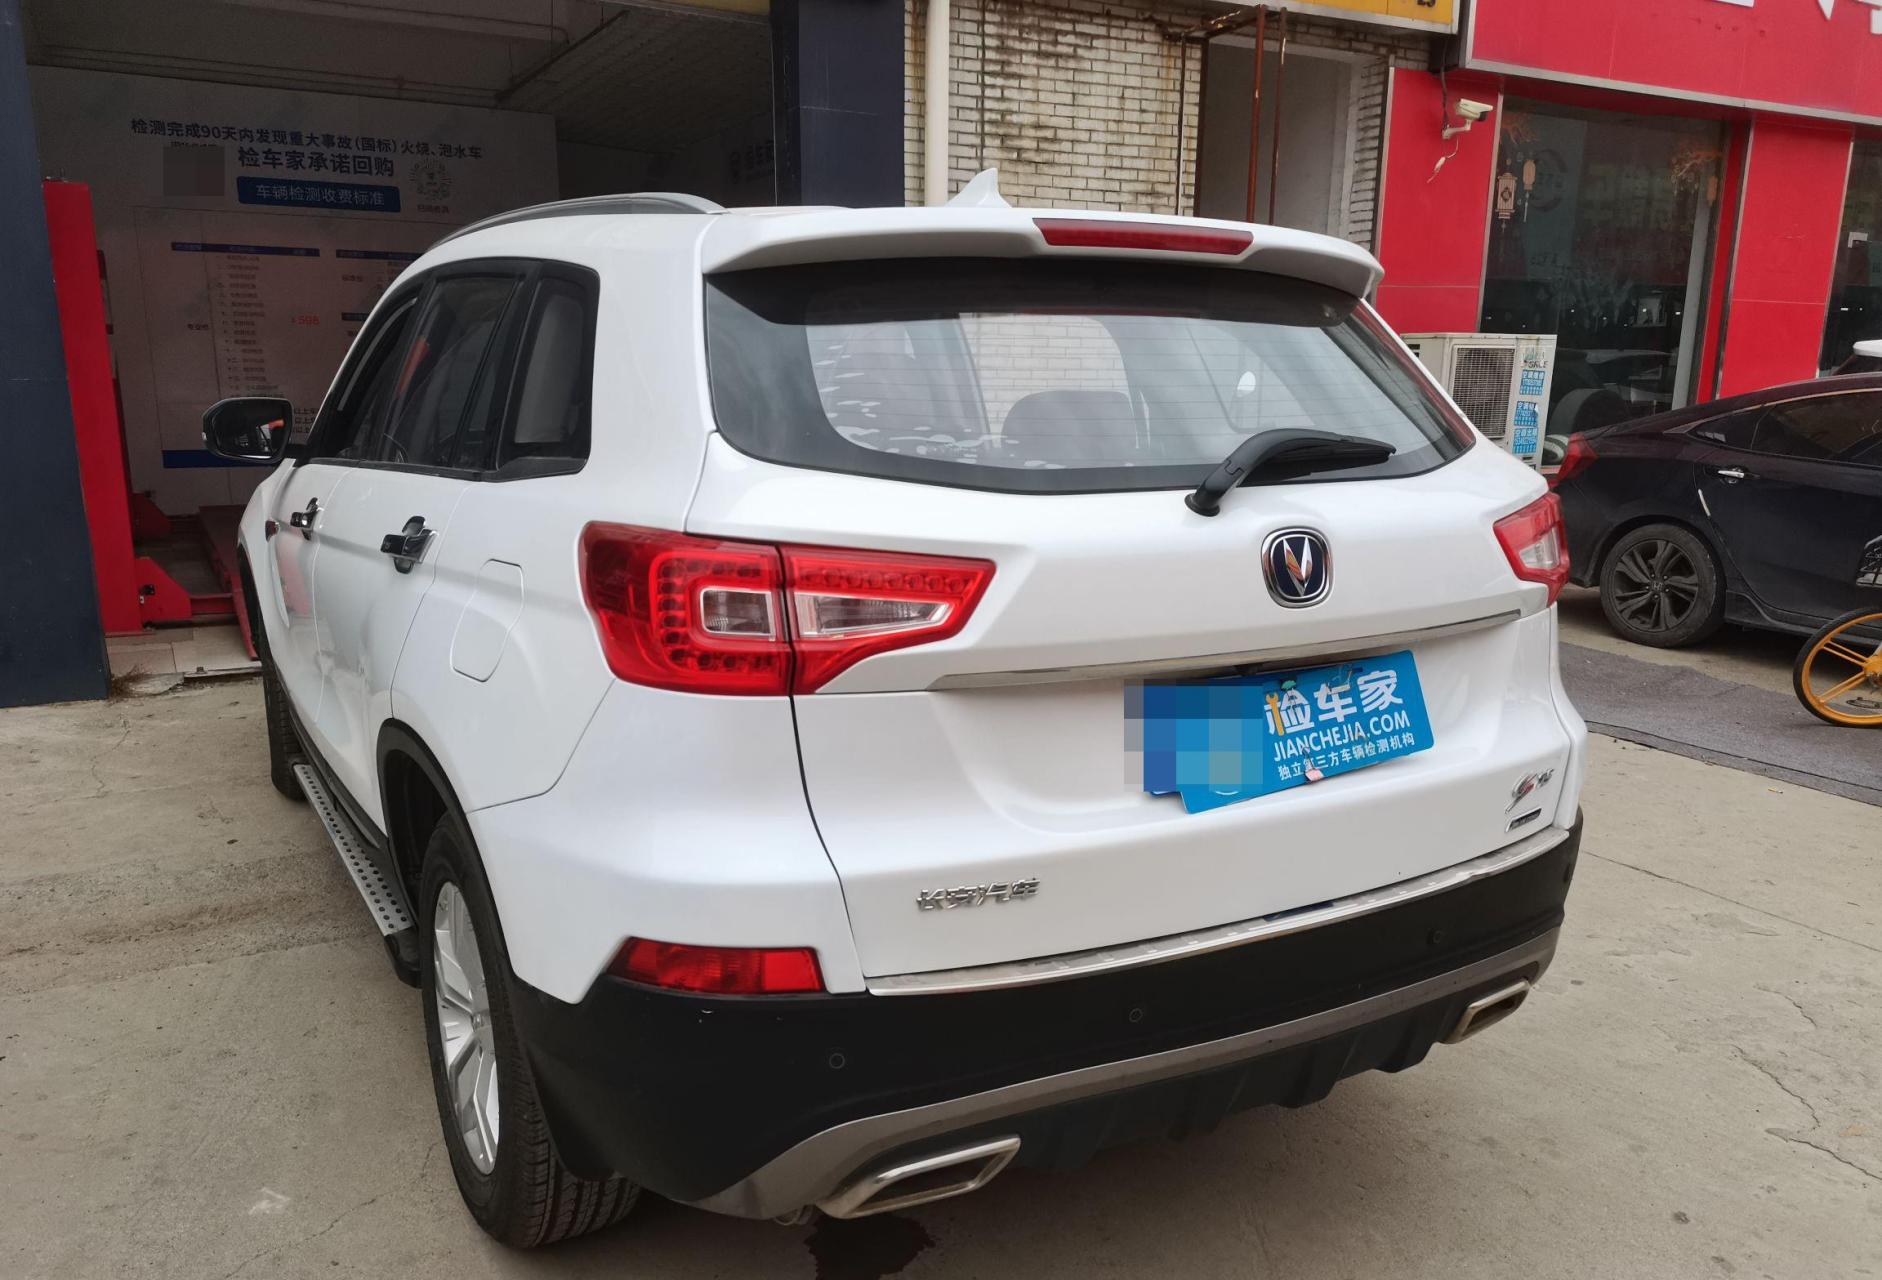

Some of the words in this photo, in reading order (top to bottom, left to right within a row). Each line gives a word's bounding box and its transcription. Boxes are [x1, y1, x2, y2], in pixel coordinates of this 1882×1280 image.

[238, 147, 395, 177] 检车家承诺回购
[255, 184, 385, 206] 车辆检测收费标准
[1264, 669, 1403, 736] 检车家
[1274, 710, 1410, 762] JIANCHEJIA.COM
[1278, 734, 1415, 781] 独立第三方车辆检测机构
